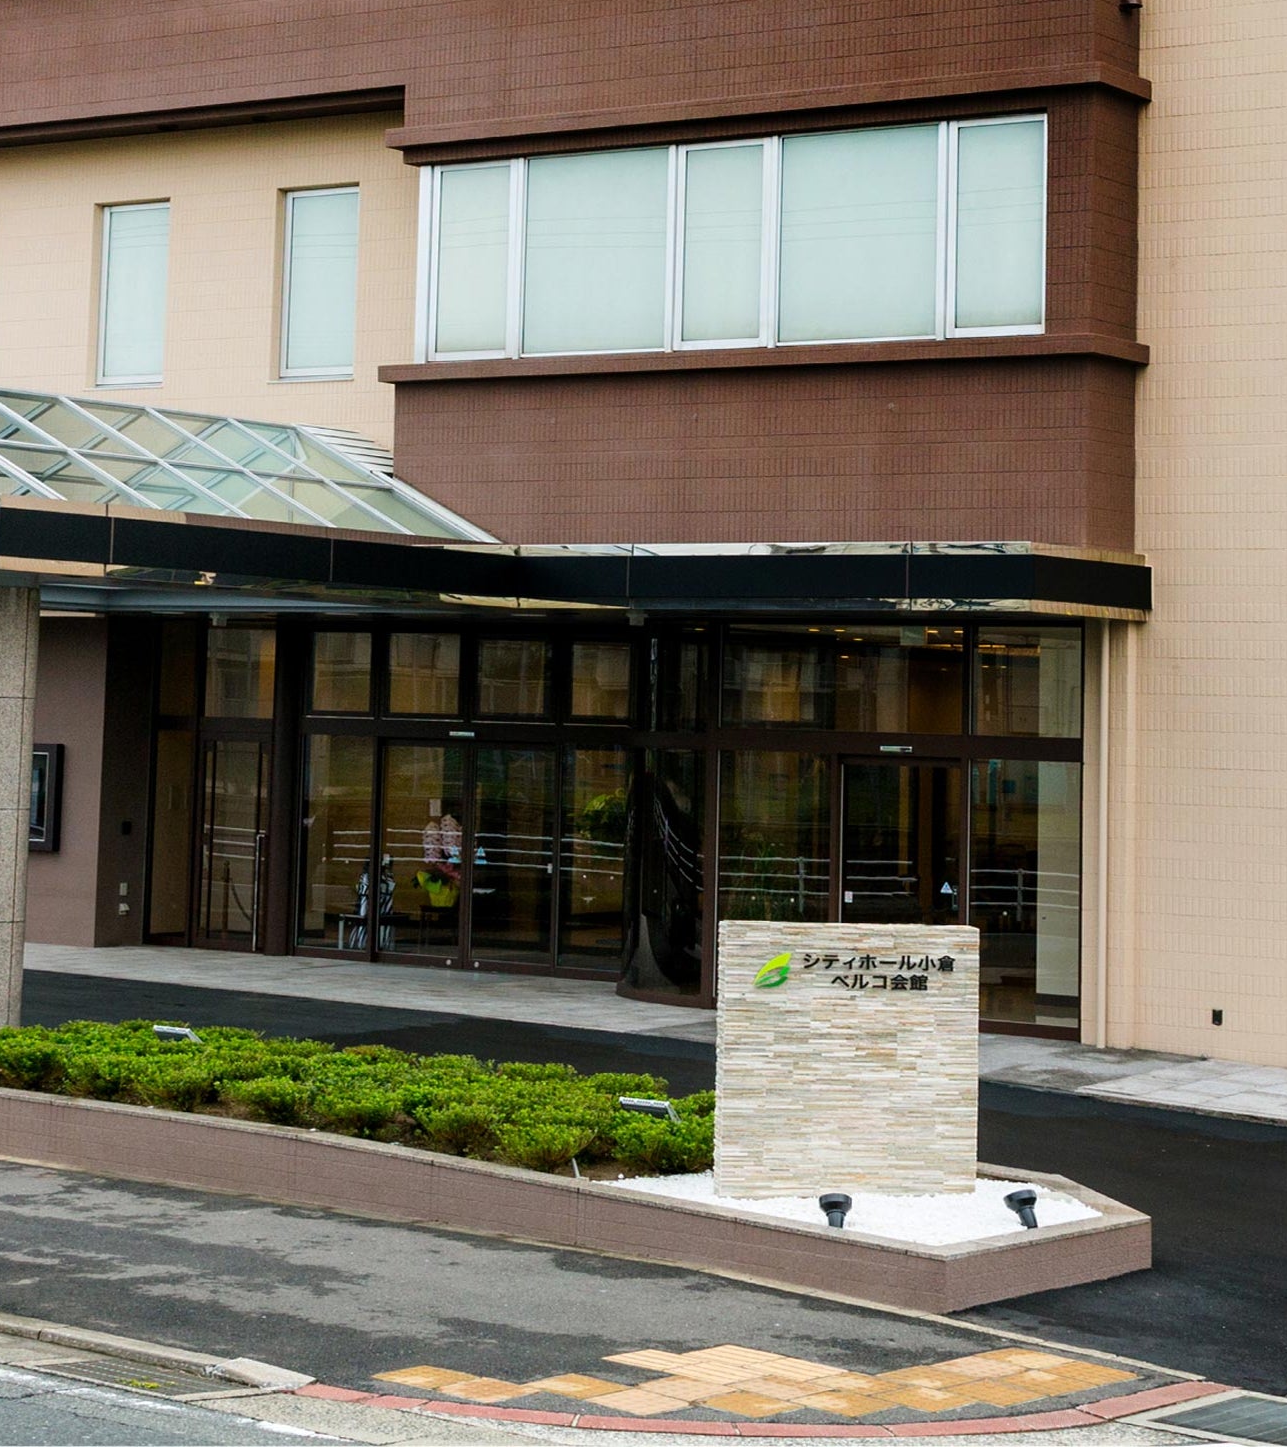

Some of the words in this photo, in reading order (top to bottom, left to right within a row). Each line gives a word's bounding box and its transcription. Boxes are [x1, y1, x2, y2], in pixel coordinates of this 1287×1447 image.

[803, 954, 956, 972] シティホール小倉
[831, 974, 928, 991] ベルコ会館
